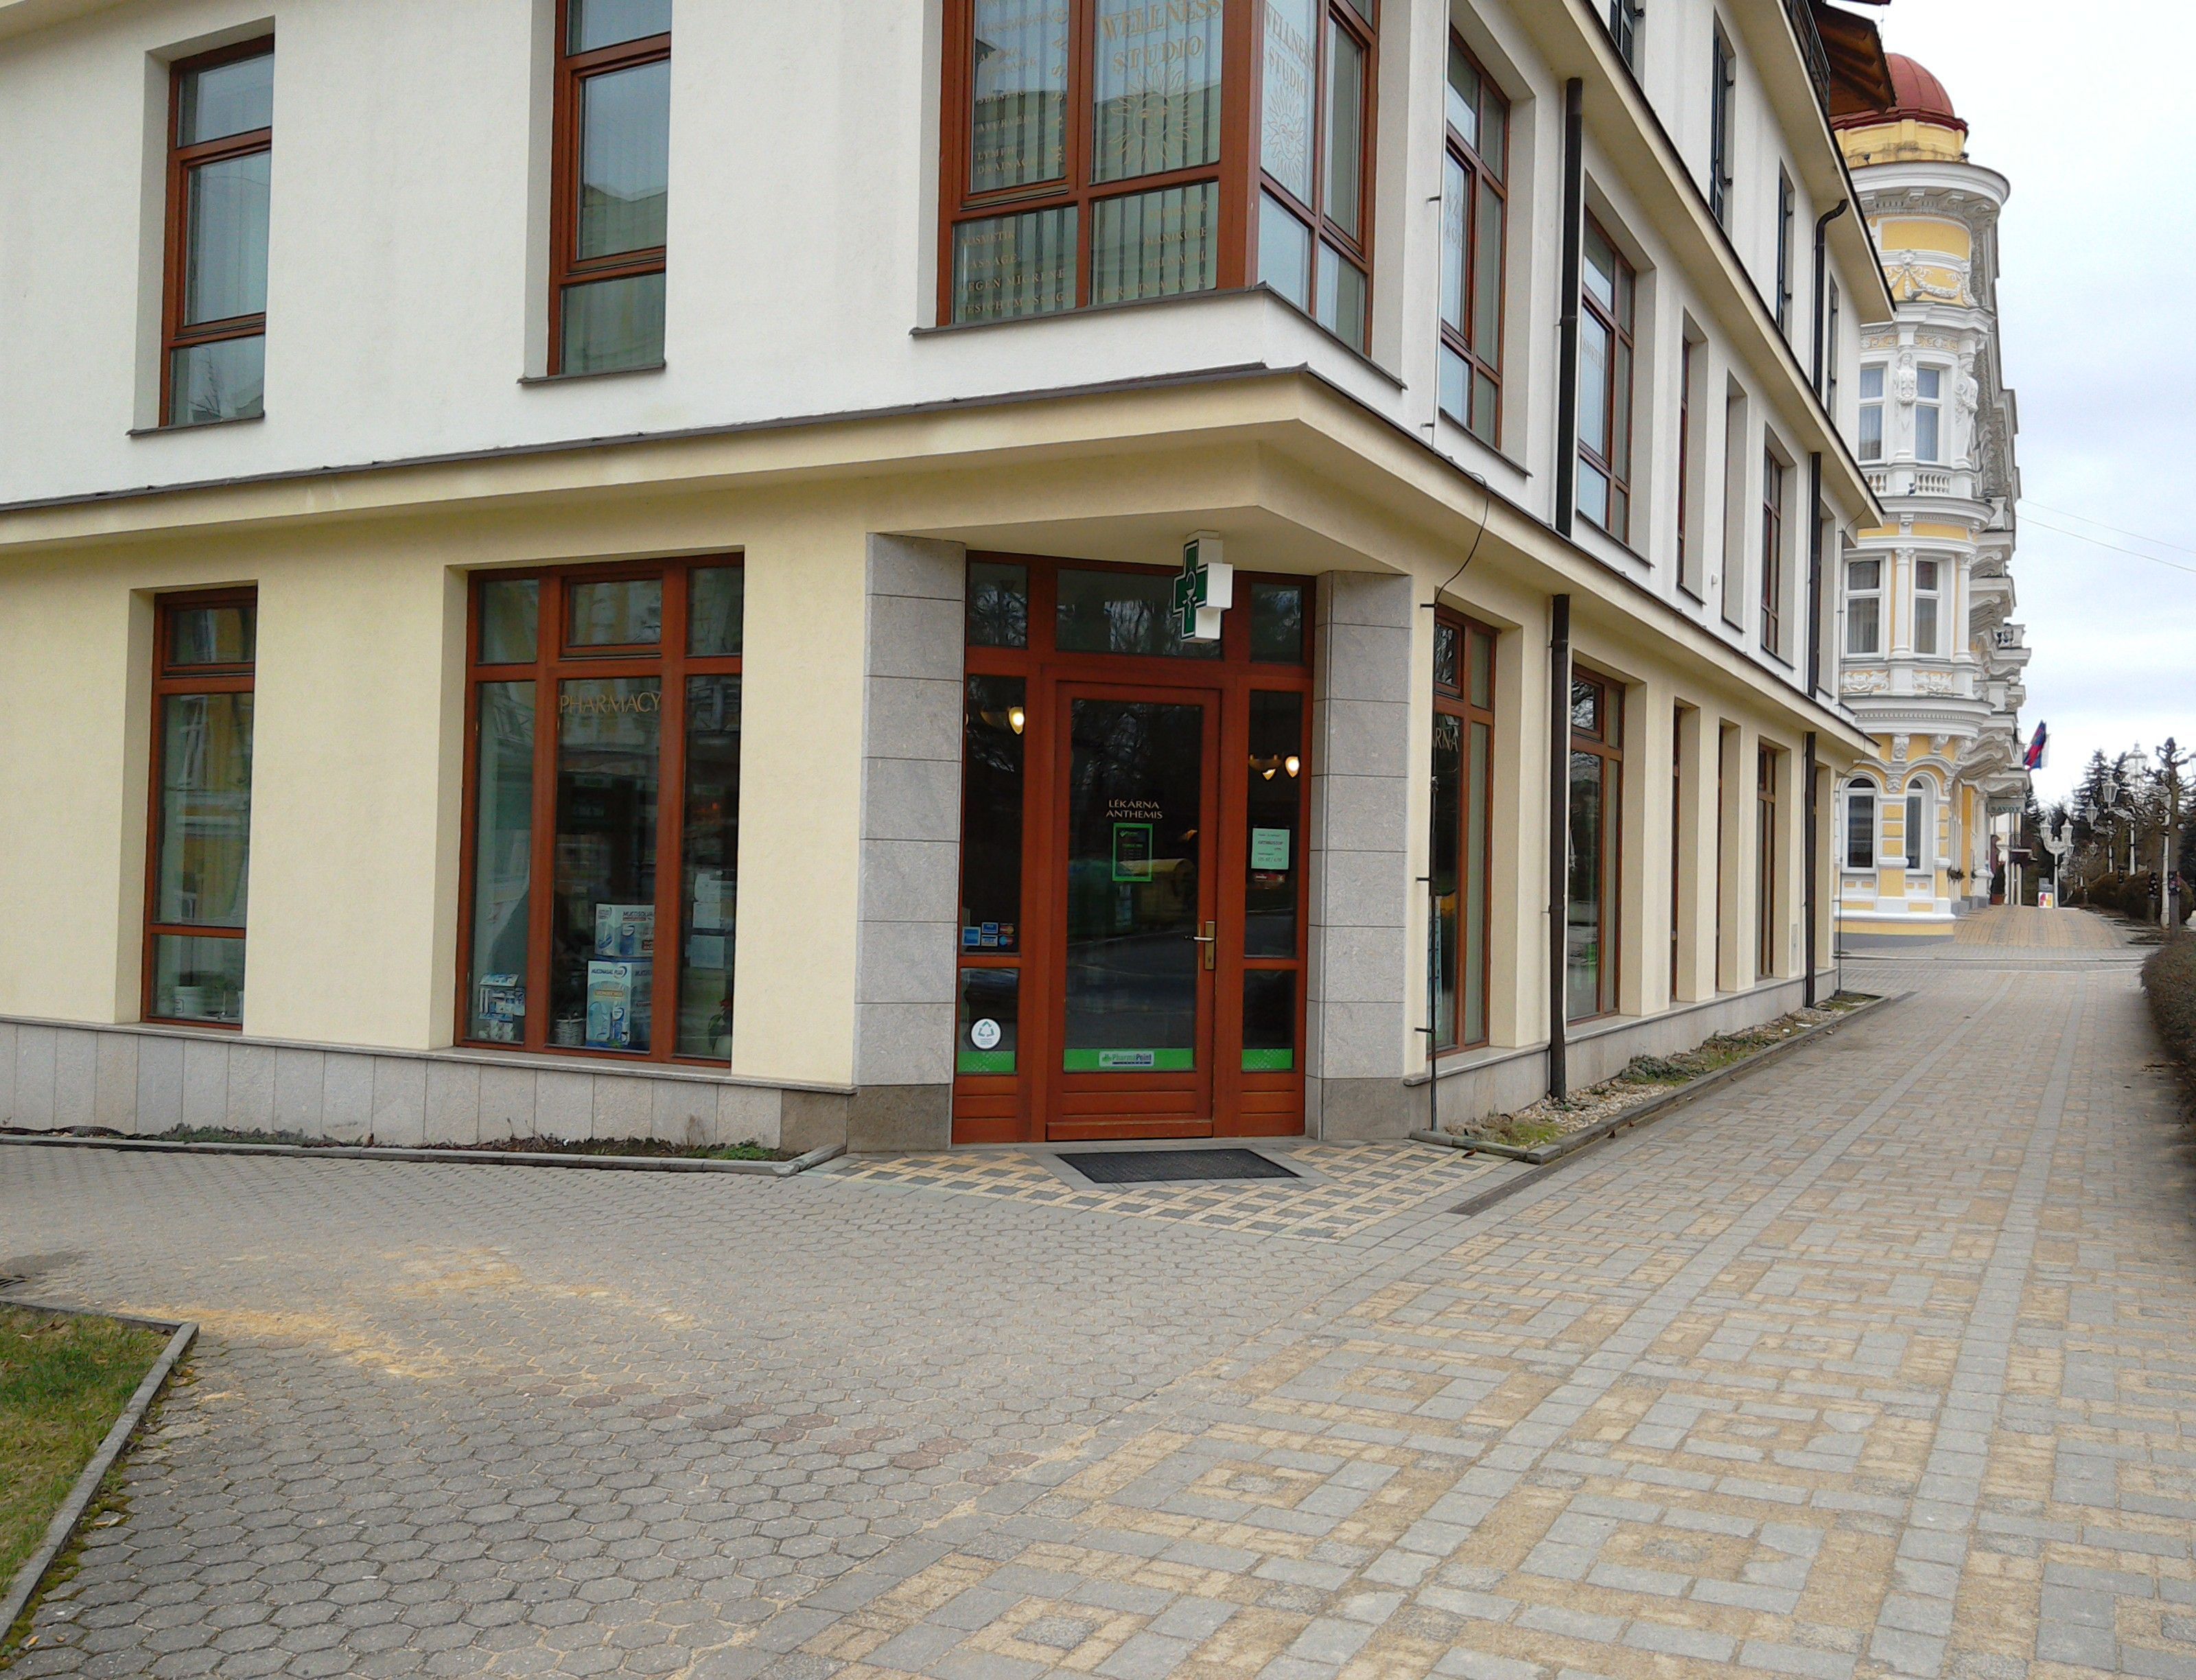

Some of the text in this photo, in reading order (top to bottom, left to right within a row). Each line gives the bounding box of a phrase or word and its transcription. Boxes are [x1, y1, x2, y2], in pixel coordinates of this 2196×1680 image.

[1100, 0, 1220, 43] WELLNESS
[1114, 36, 1203, 73] STUDIO
[1269, 45, 1307, 97] STUDIO
[560, 692, 662, 714] PHARMACY
[1106, 810, 1163, 819] ANTHEMIS
[1108, 799, 1160, 809] LÉKÁRNA
